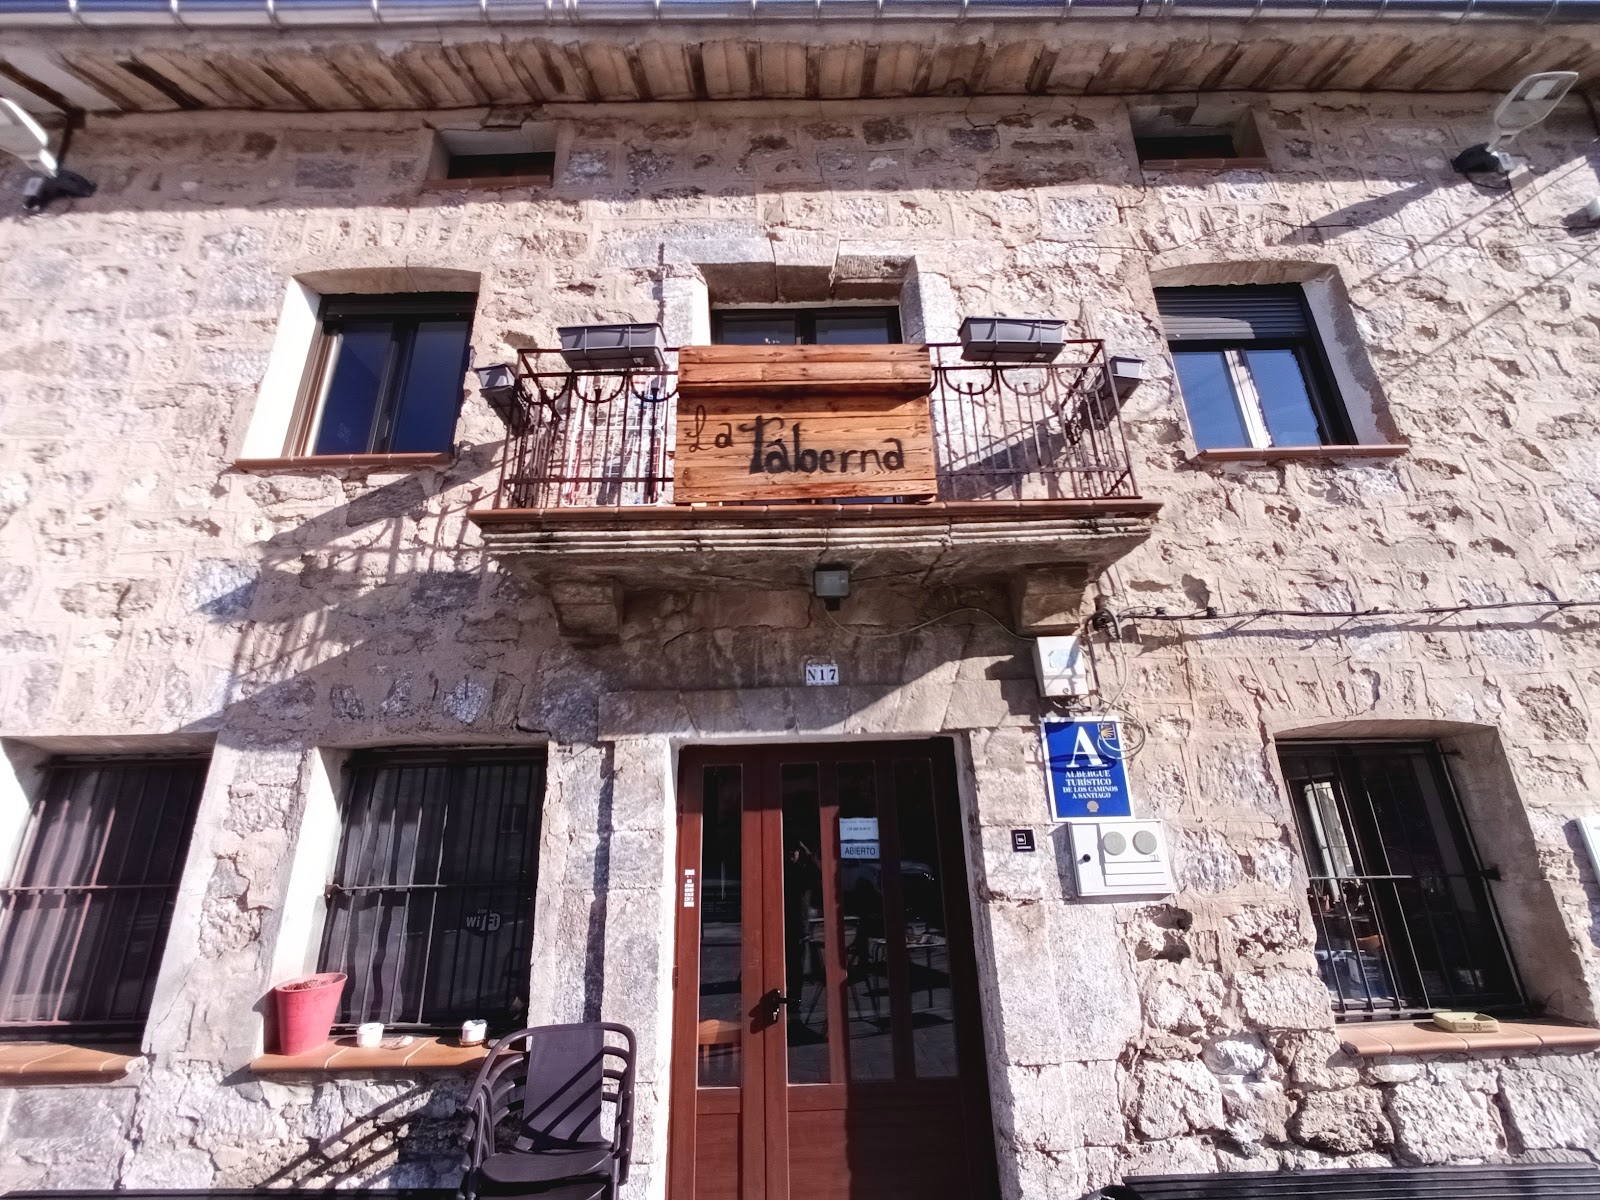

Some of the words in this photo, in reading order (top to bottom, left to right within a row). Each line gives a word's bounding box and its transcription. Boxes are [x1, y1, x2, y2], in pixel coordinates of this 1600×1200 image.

[683, 404, 734, 453] La
[1066, 726, 1108, 767] A
[1065, 770, 1111, 778] ALBERGUE
[1066, 777, 1111, 786] TURÍSTICO
[1087, 785, 1119, 793] CAMINOS
[844, 846, 876, 856] ABIERTO
